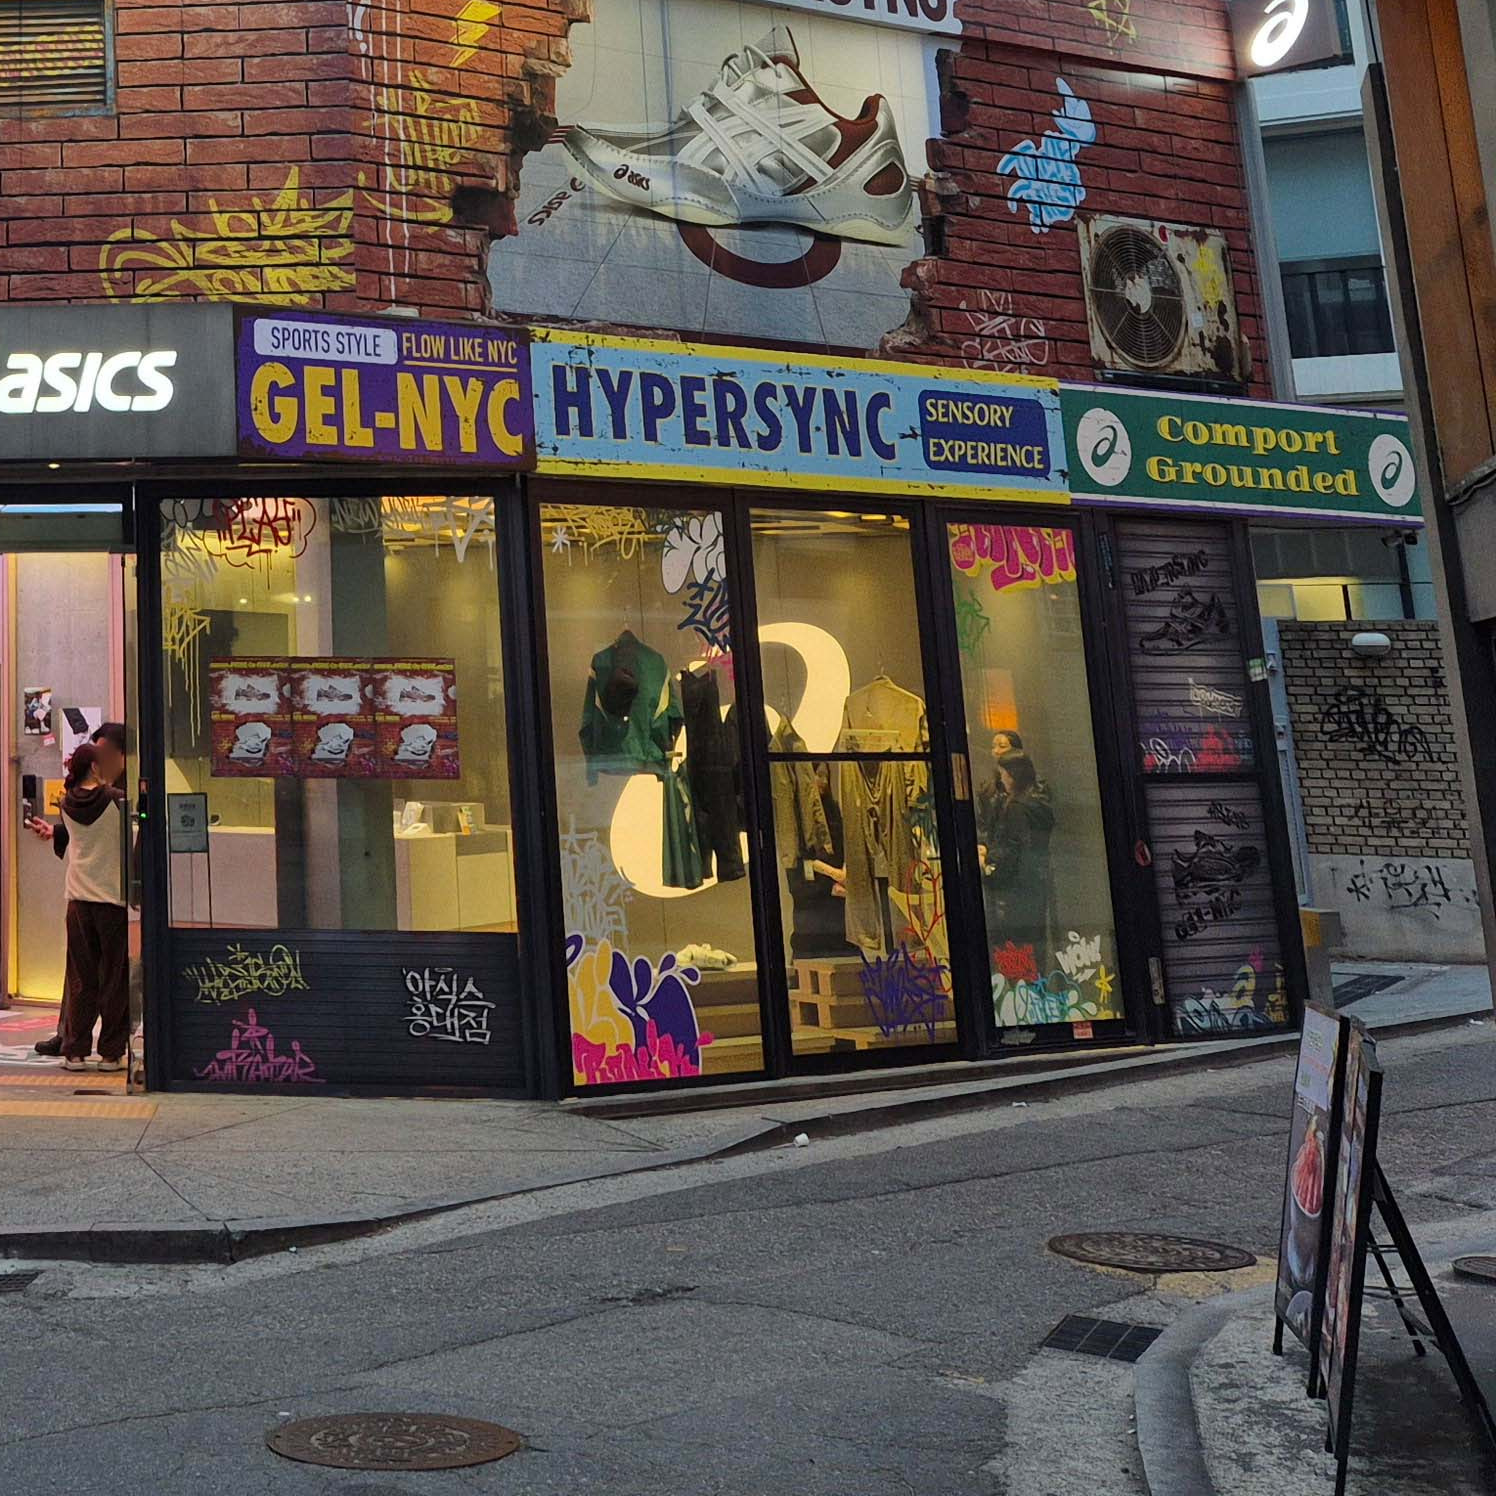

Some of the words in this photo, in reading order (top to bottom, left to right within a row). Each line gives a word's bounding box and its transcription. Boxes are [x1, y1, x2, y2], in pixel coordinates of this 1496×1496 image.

[270, 326, 331, 355] SPORTS
[335, 331, 382, 357] STYLE
[402, 332, 446, 361] FLOW
[450, 337, 484, 363] LIKE
[487, 339, 518, 365] NYC
[250, 361, 524, 457] GEL-NYC
[551, 362, 897, 464] HYPERSYNC
[925, 398, 1014, 429] SENSORY
[929, 438, 1045, 470] EXPERIENCE
[1156, 414, 1341, 456] Comport
[1145, 455, 1361, 497] Grounded
[402, 967, 496, 1009] 아식스
[401, 998, 492, 1045] 홍대점
